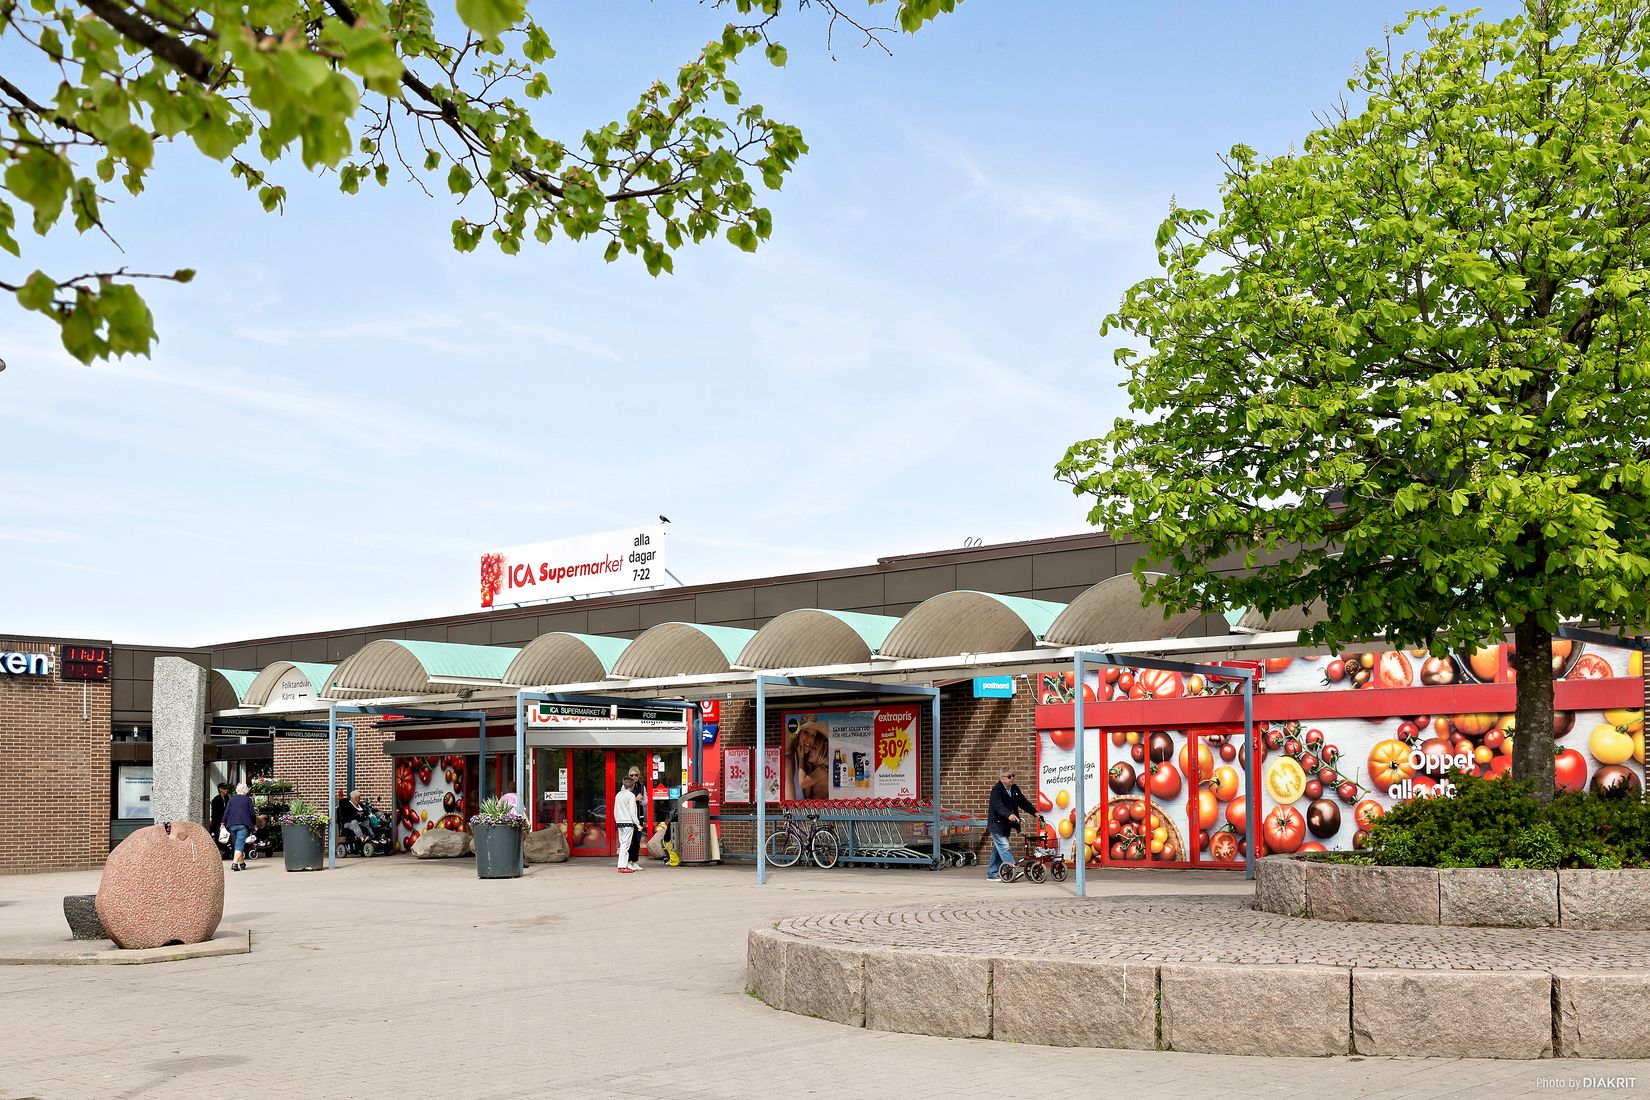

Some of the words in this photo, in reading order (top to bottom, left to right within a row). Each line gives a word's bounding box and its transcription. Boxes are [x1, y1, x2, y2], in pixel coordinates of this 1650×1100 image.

[633, 533, 651, 547] alla
[628, 549, 657, 564] dagar
[508, 562, 536, 589] ICA
[538, 553, 624, 584] Supermarket
[632, 568, 651, 582] 7-22
[982, 682, 1010, 691] postnord
[549, 706, 559, 714] ICA
[560, 707, 601, 716] SUPERMARKET
[878, 711, 912, 723] extrapris
[880, 739, 908, 758] 30%
[1408, 746, 1475, 775] Öppet
[730, 765, 745, 779] 33:-
[1042, 765, 1057, 774] Den
[1388, 778, 1426, 799] alla
